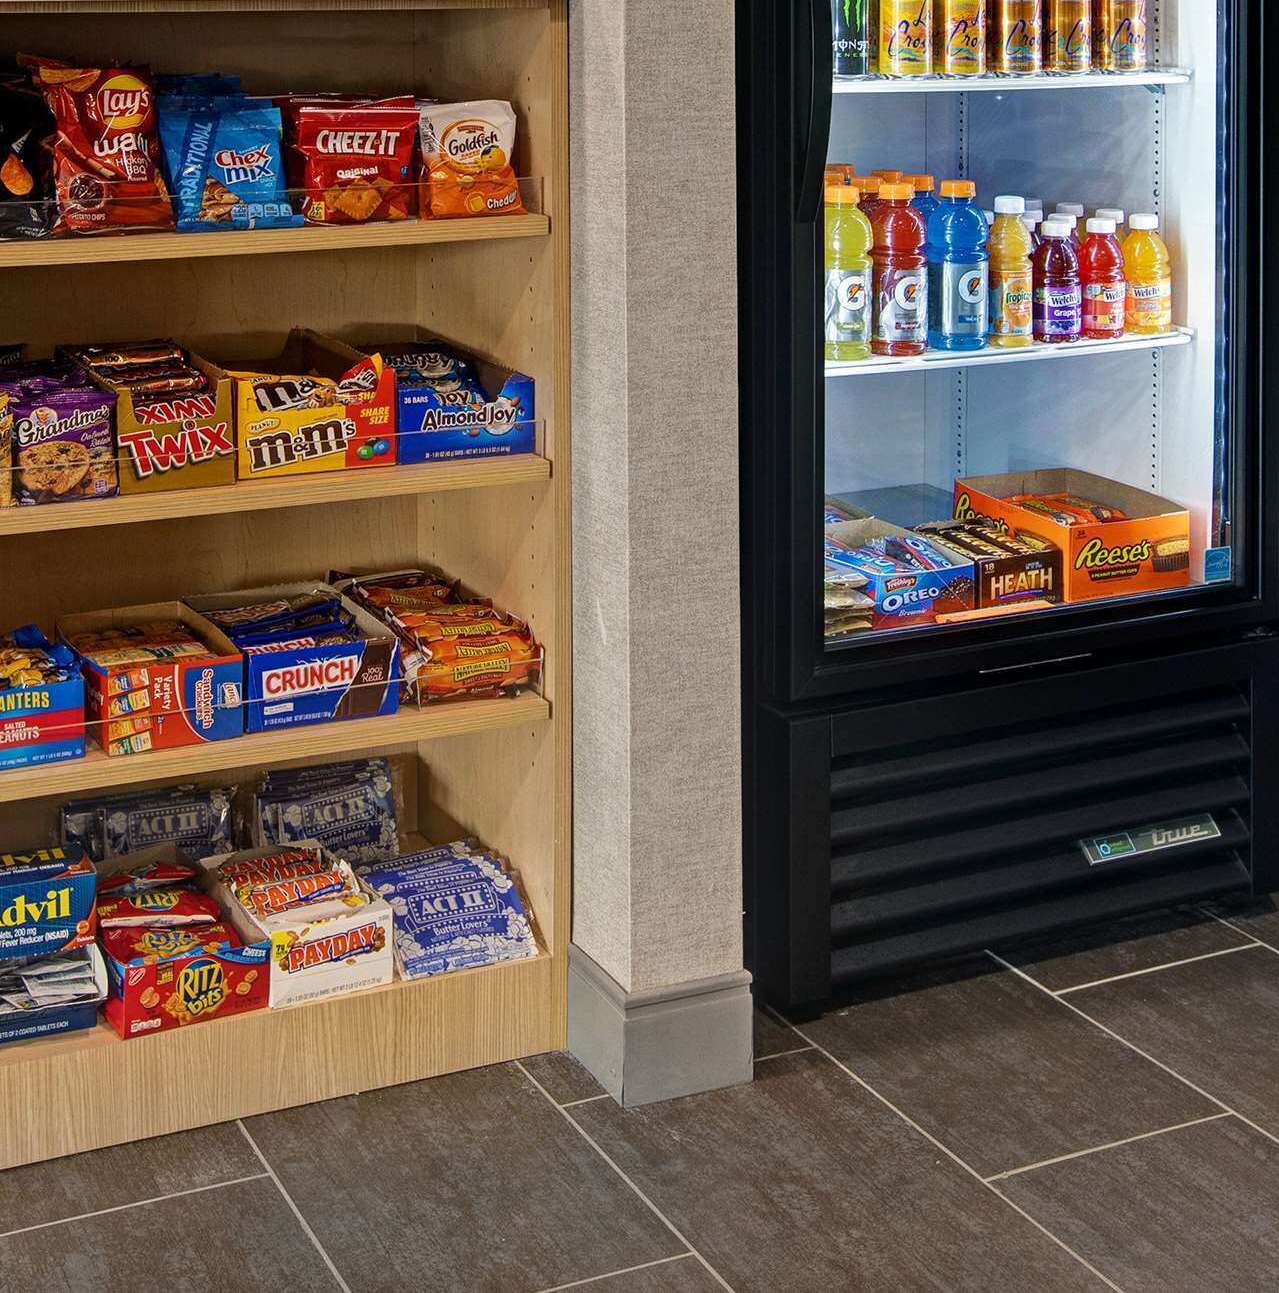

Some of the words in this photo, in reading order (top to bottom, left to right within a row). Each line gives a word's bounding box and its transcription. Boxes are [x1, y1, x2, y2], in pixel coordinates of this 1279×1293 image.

[103, 86, 150, 118] Lay's
[215, 143, 272, 169] Chex
[448, 130, 498, 157] Goldfish
[223, 159, 274, 185] mix
[359, 406, 390, 418] SHARE
[412, 395, 429, 404] BARS
[14, 404, 110, 447] Grandma's
[369, 415, 389, 425] SIZE
[421, 405, 487, 433] Almond
[488, 404, 516, 426] Joy
[246, 417, 357, 473] m&m's
[984, 562, 995, 571] 18
[1074, 537, 1152, 570] Reese's
[990, 566, 1053, 601] HEATH
[881, 586, 940, 613] OREO
[154, 676, 163, 700] Pack
[264, 657, 357, 695] CRUNCH
[361, 672, 384, 683] Real
[163, 675, 173, 710] Variety
[202, 667, 215, 730] Sandwich
[3, 721, 26, 731] SALTED
[139, 815, 175, 836] ACT
[177, 811, 199, 831] II
[313, 802, 345, 825] ACT
[1148, 824, 1208, 846] true
[251, 870, 345, 916] PAYDAY
[421, 894, 459, 917] ACT
[459, 890, 485, 908] II
[13, 929, 24, 937] 200
[26, 927, 37, 936] mg
[19, 935, 44, 945] Reducer
[44, 929, 70, 943] (NSAID)
[433, 923, 461, 937] Butter
[241, 946, 267, 957] CHEESE
[288, 923, 377, 973] PAYDAY
[177, 962, 223, 1001] RITZ
[184, 986, 225, 1016] bits
[18, 1026, 37, 1036] COATED
[37, 1023, 57, 1034] TABLETS
[56, 1020, 69, 1030] EACH
